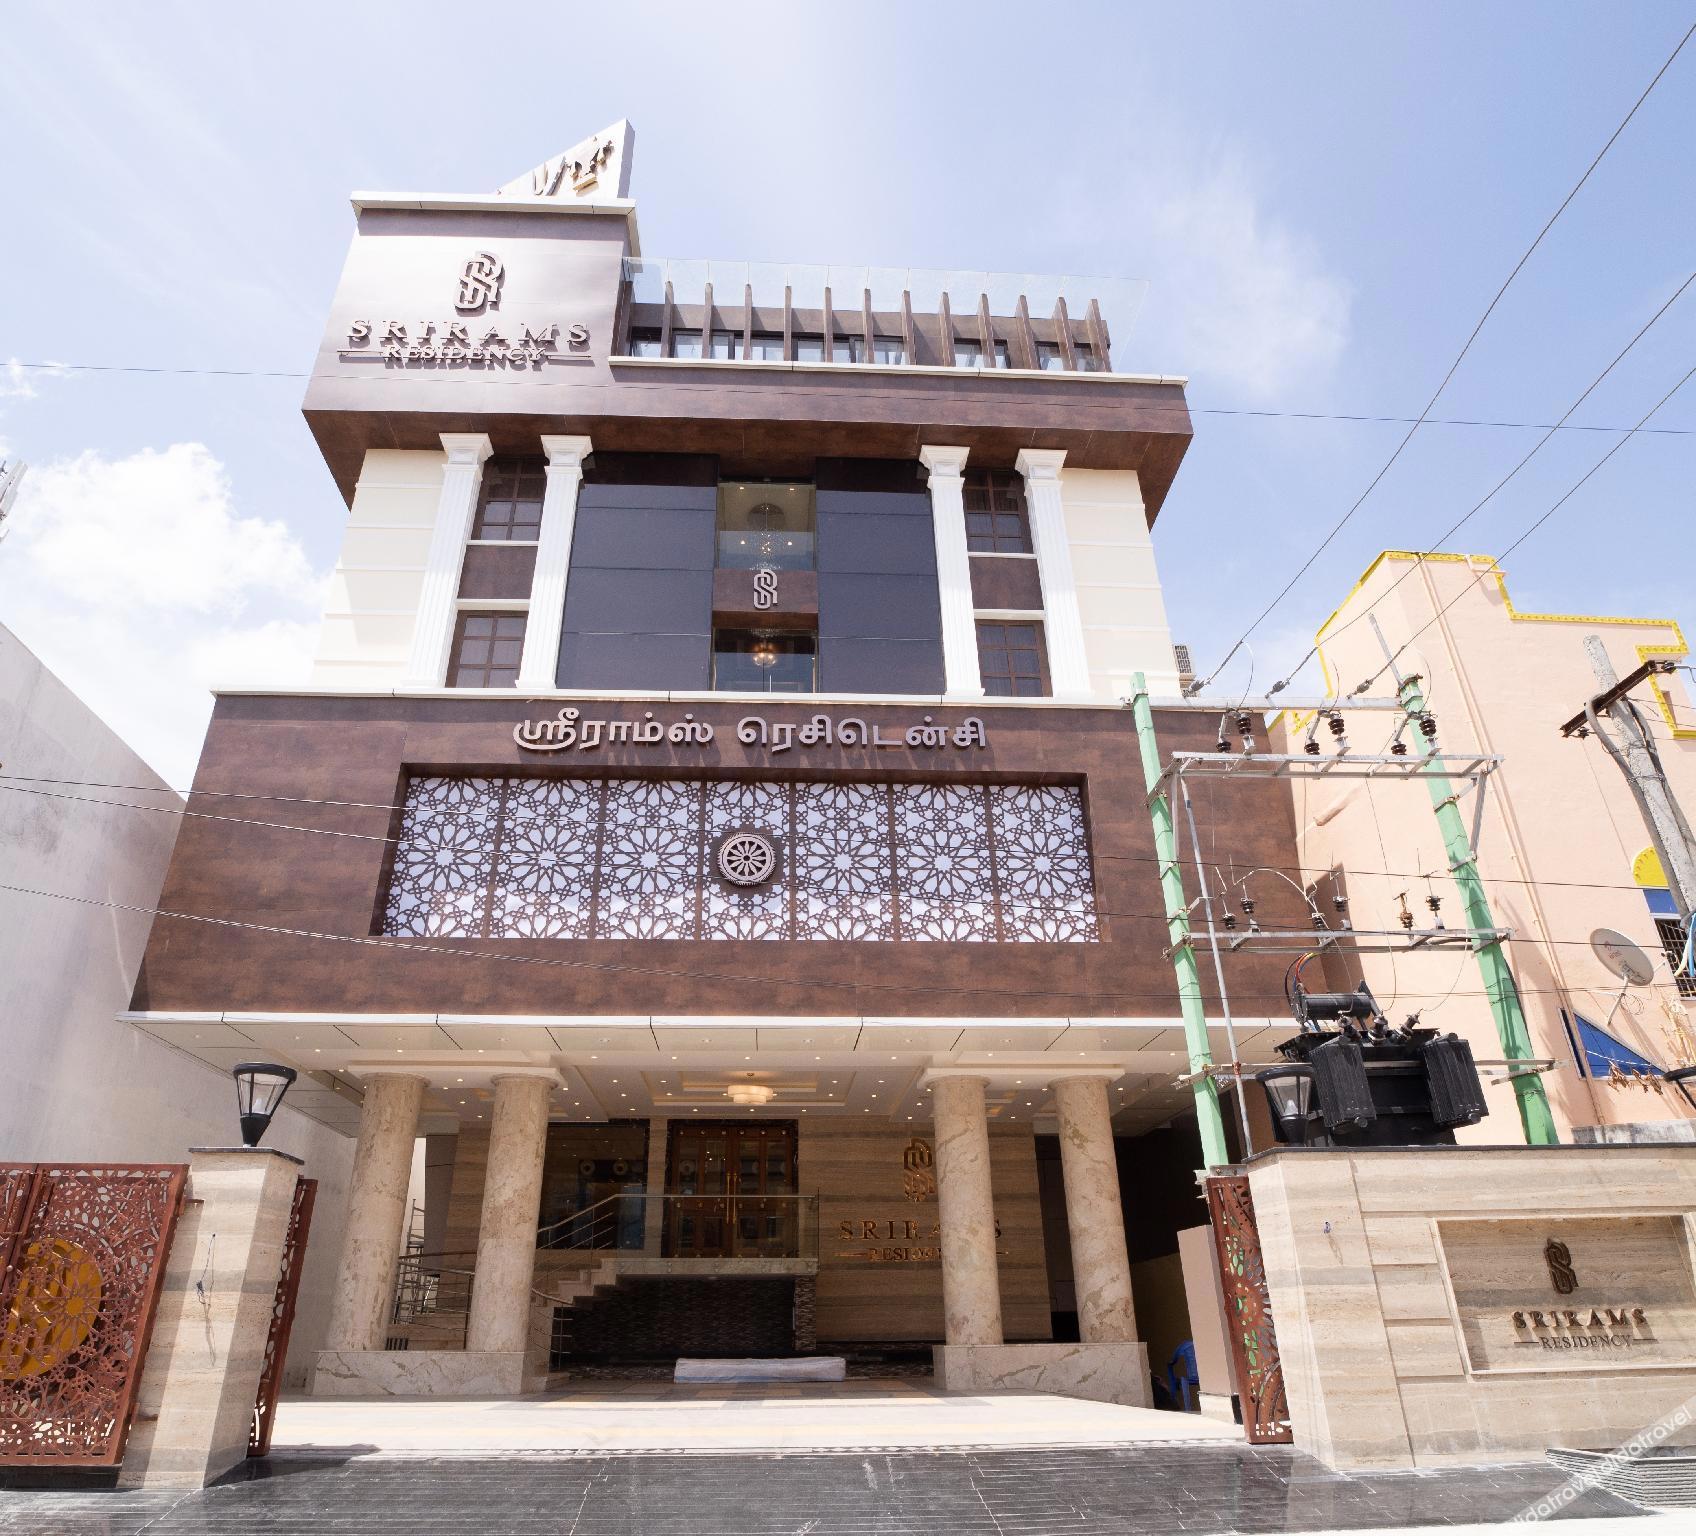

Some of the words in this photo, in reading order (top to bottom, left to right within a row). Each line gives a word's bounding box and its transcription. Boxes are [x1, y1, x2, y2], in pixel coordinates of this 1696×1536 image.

[347, 319, 589, 345] SRIRAMS
[384, 344, 548, 362] RESIDENCY
[736, 714, 987, 753] ரெசிடென்சி
[1512, 1308, 1646, 1329] SRIRAMS
[1538, 1334, 1633, 1350] RESIDENCY
